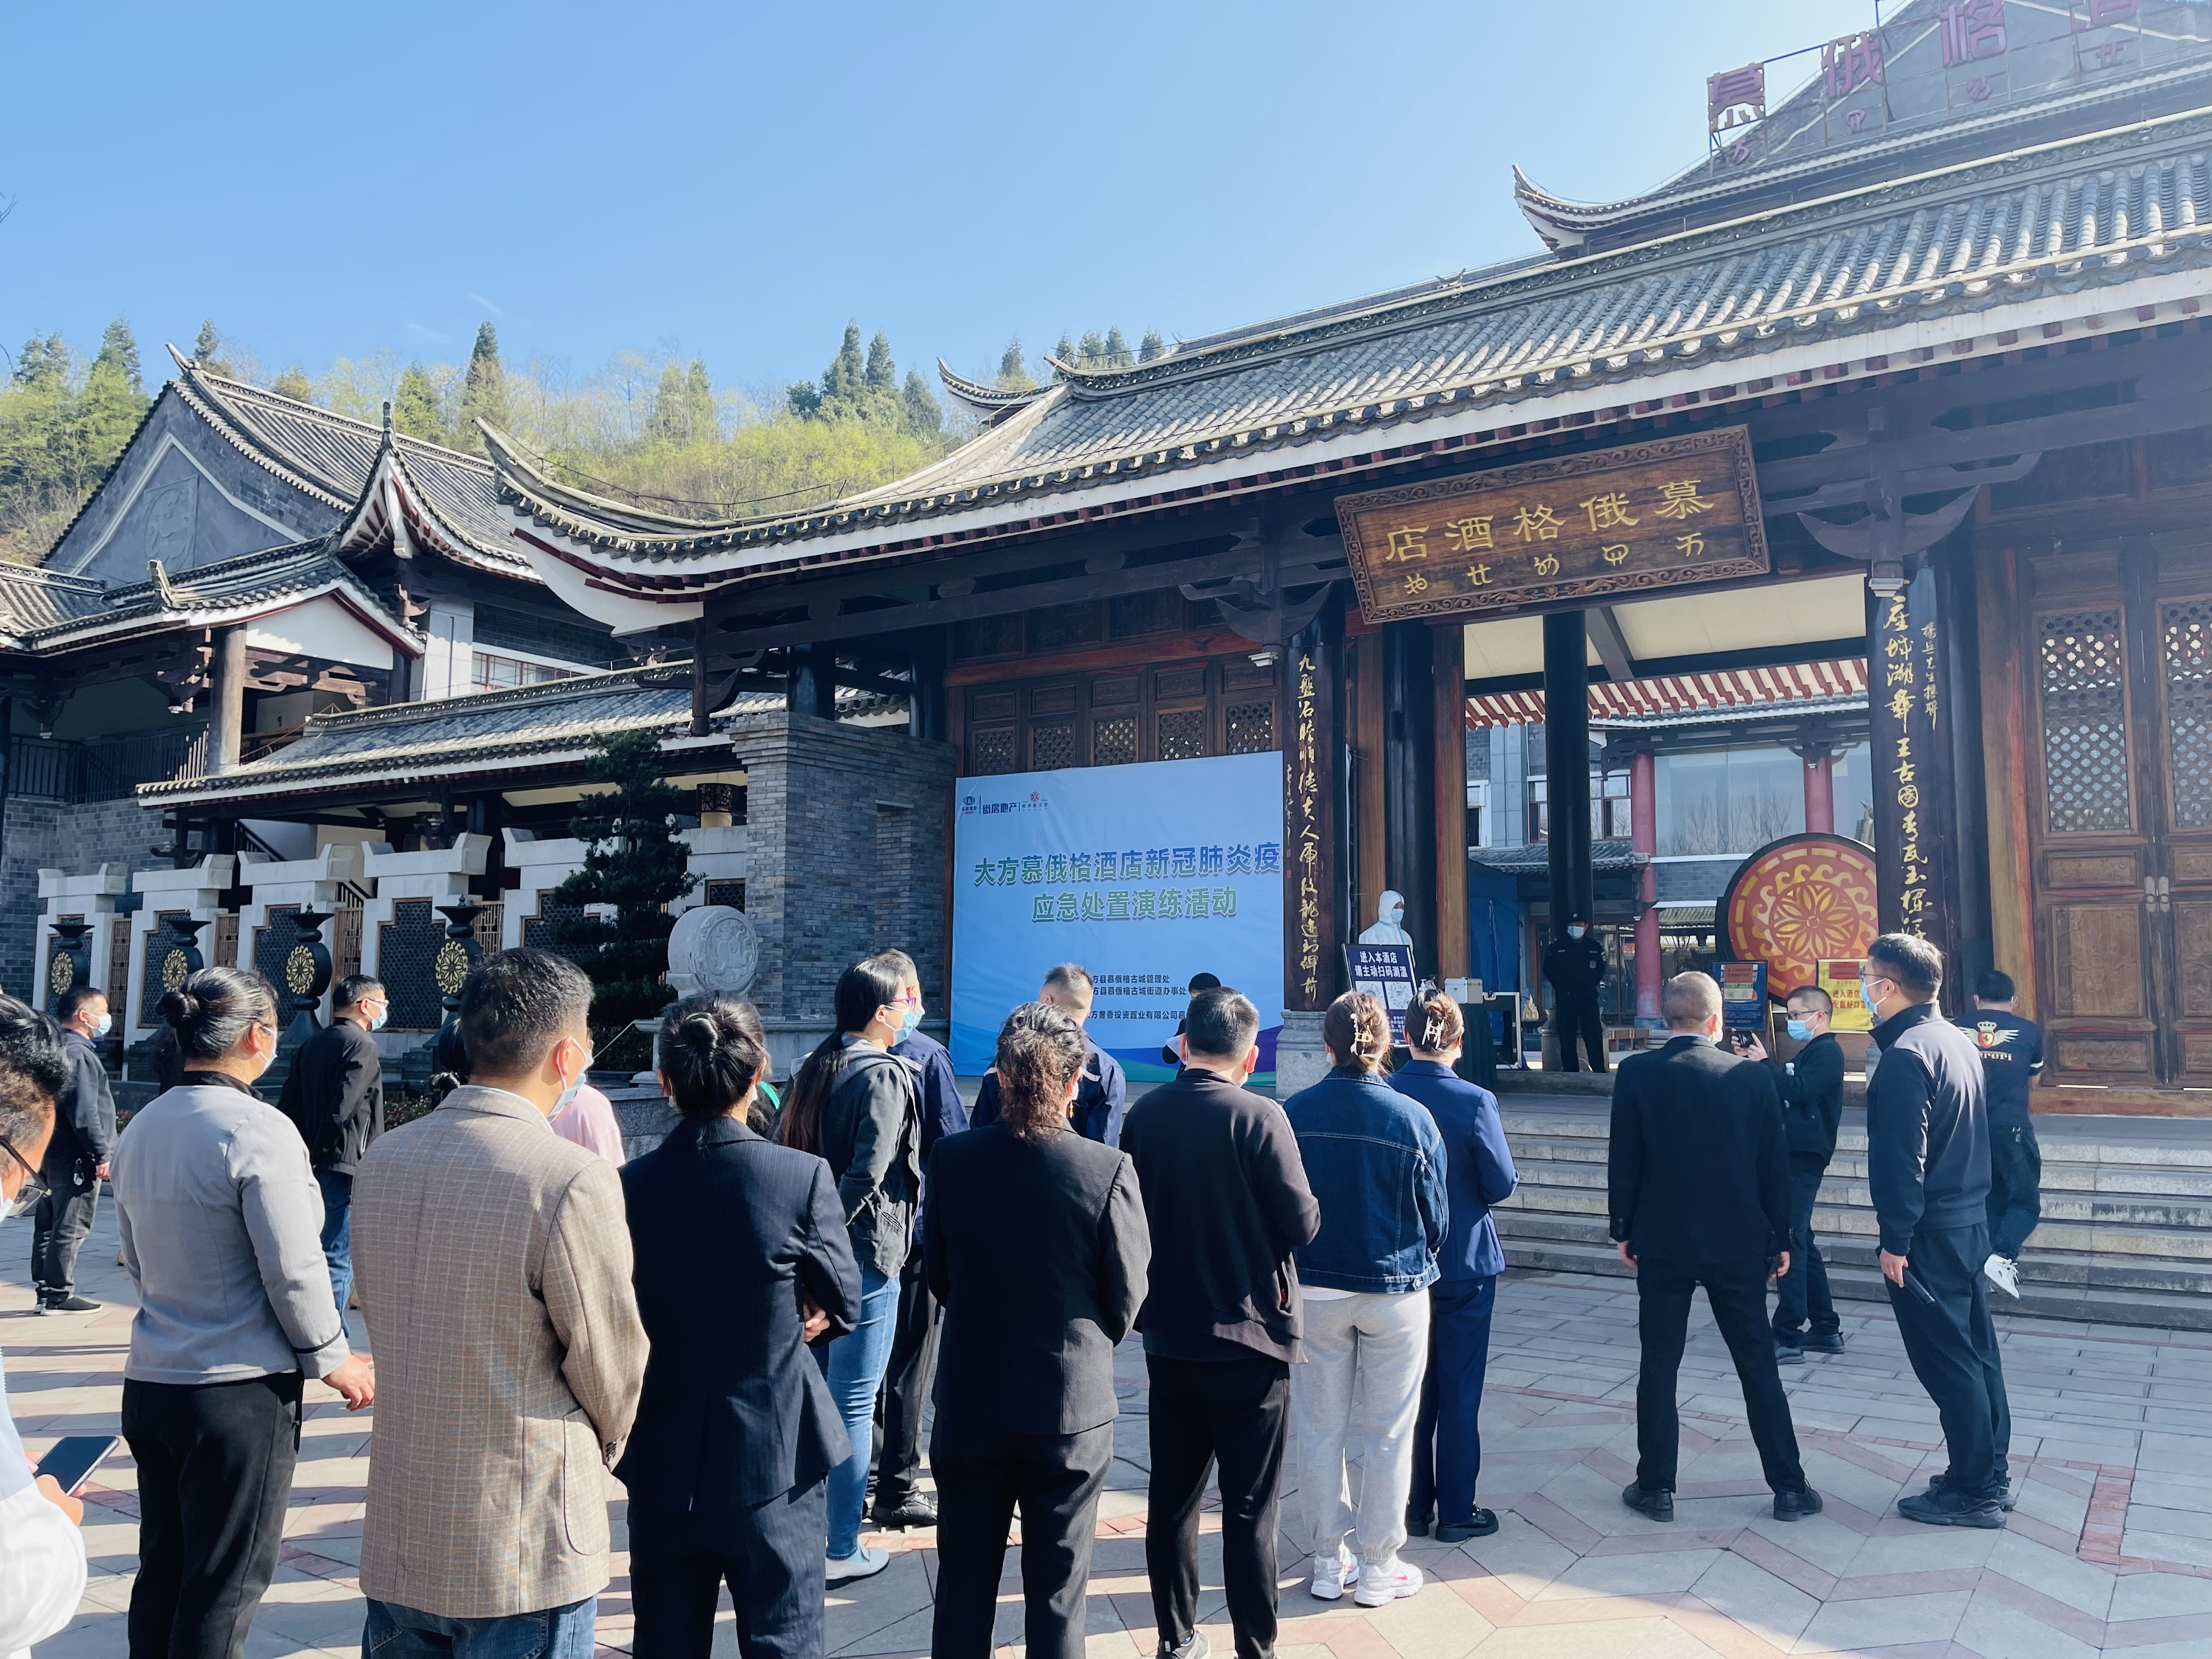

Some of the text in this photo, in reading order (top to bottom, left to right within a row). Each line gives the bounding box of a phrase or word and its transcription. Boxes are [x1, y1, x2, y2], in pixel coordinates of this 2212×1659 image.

[1386, 479, 1714, 562] 慕俄格酒店
[974, 842, 1282, 886] 大方慕俄格酒店新冠肺炎疫
[1032, 885, 1237, 922] 应急处置演练活动
[1359, 951, 1397, 964] 进入本酒店
[1355, 964, 1408, 978] 请主动扫码测温
[1092, 974, 1170, 984] 方县慕俄格古城管理处
[1093, 986, 1187, 995] 方县慕俄格古城街道办事处
[1087, 1010, 1186, 1019] 方奢香投资置业有限公司慕
